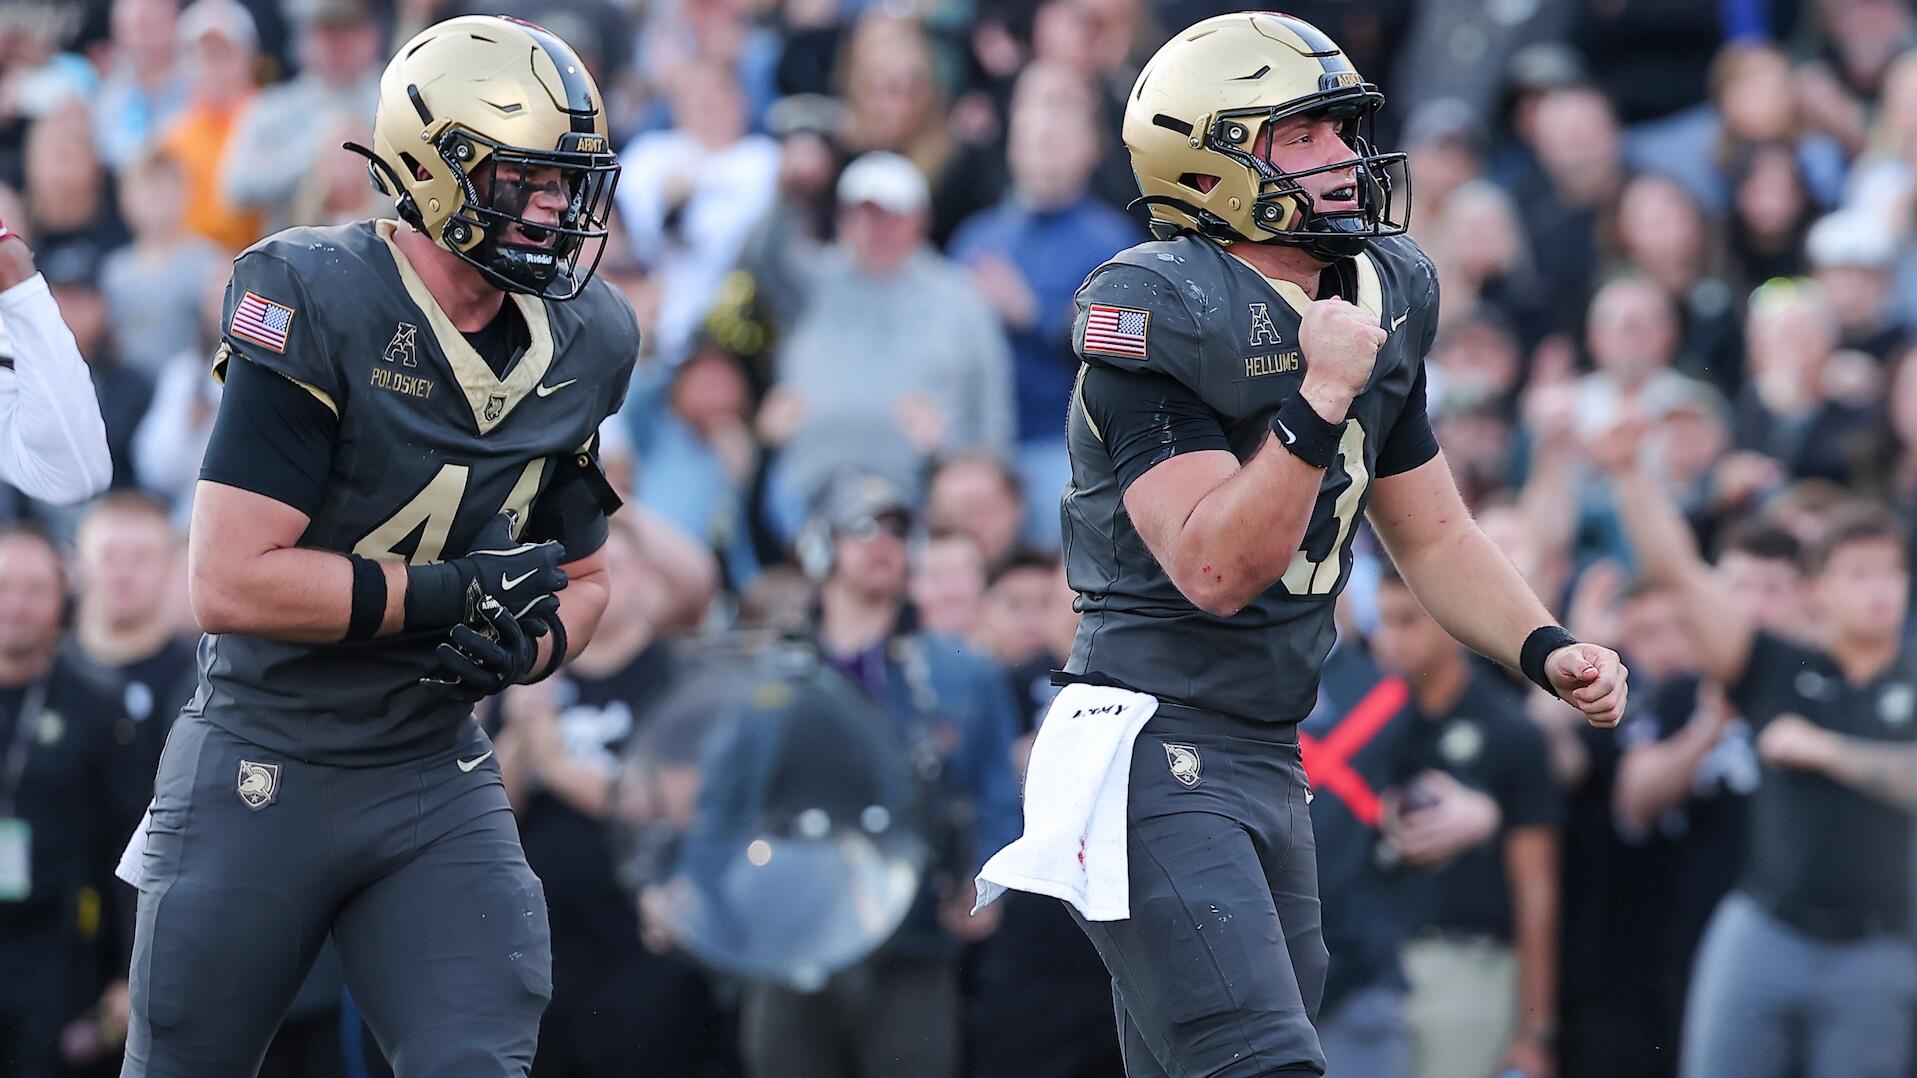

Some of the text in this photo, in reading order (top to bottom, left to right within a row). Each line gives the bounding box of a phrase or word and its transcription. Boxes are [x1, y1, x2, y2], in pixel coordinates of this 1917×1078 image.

[576, 137, 602, 152] ARMY
[1248, 303, 1281, 346] A
[383, 321, 417, 368] A
[1245, 352, 1299, 377] HELLUMS
[370, 367, 434, 398] POLOSKEY
